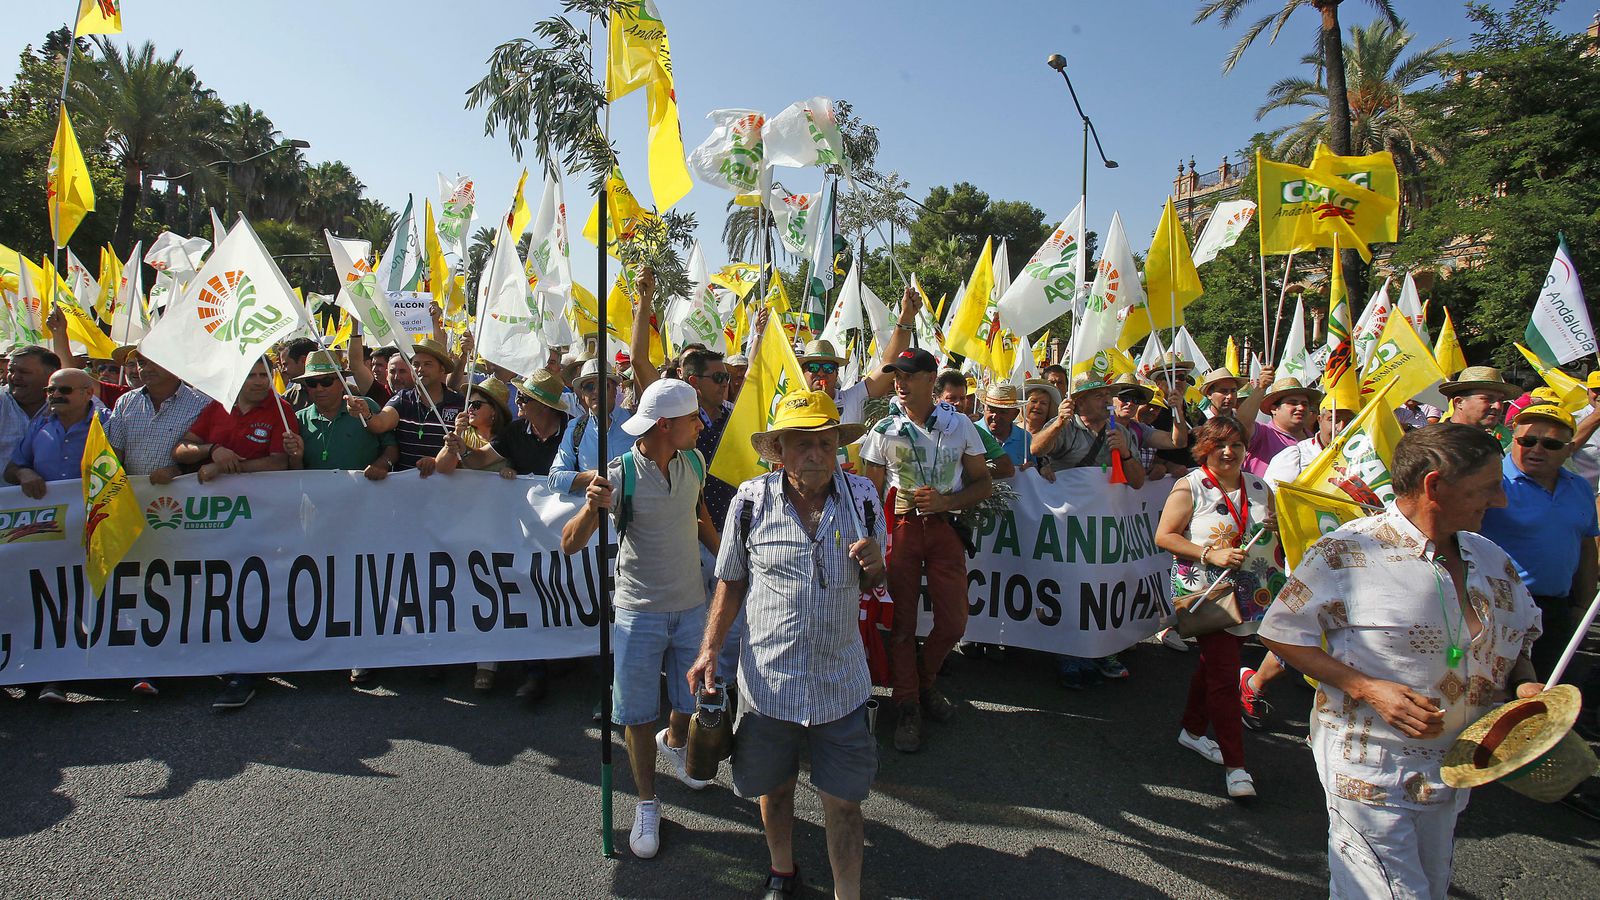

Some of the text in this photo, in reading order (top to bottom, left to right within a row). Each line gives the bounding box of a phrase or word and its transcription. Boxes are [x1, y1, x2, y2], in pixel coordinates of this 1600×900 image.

[689, 308, 719, 348] UPA
[185, 496, 253, 521] UPA
[974, 507, 1021, 557] PA
[29, 556, 271, 650] NUESTRO
[287, 551, 456, 641] OLIVAR
[468, 550, 529, 632] SE
[1080, 581, 1127, 631] NO
